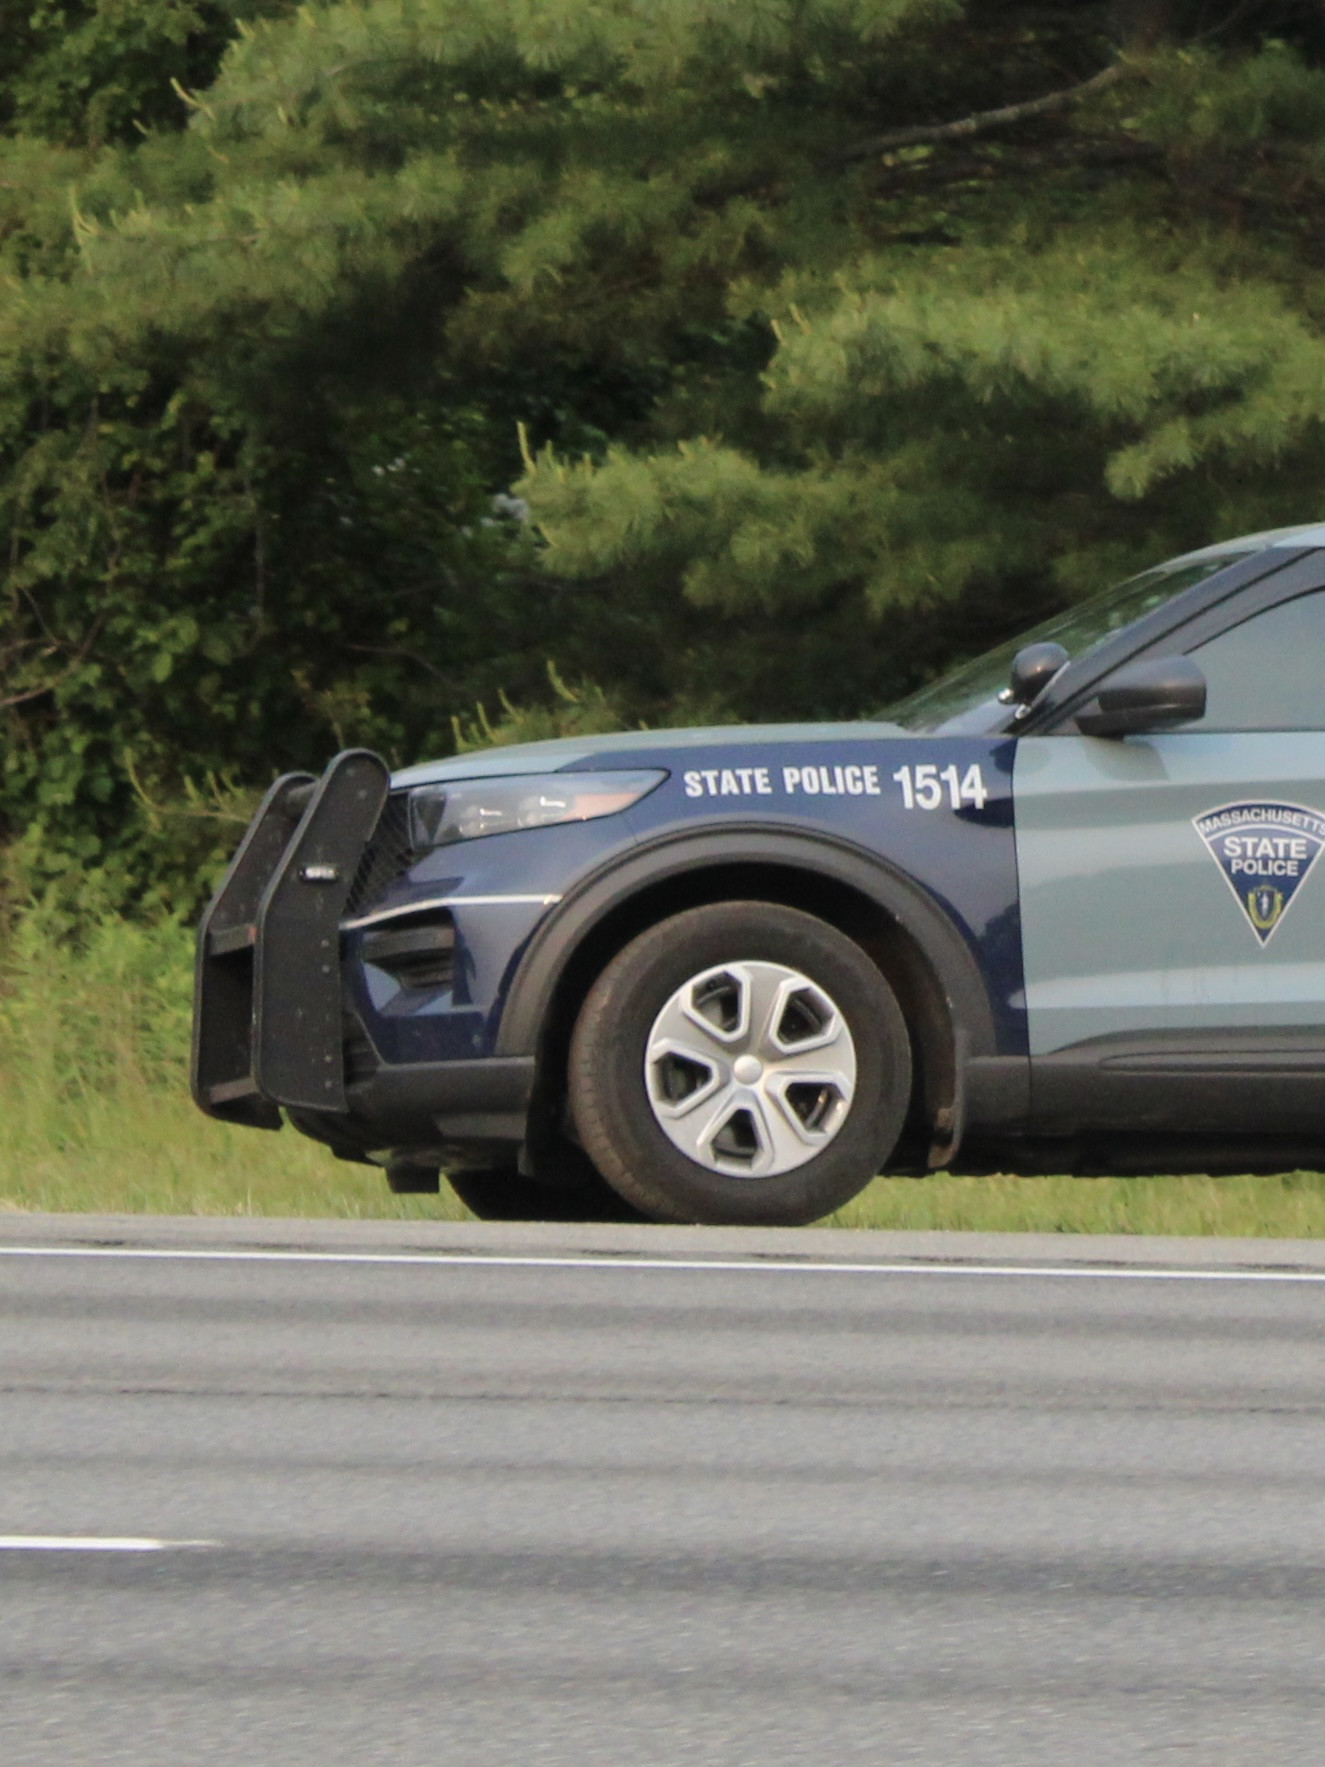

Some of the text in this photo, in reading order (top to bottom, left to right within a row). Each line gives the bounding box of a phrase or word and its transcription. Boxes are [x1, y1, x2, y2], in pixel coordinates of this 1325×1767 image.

[683, 763, 988, 810] STATE POLICE 1514
[1223, 836, 1308, 860] STATE
[1230, 859, 1299, 877] POLICE
